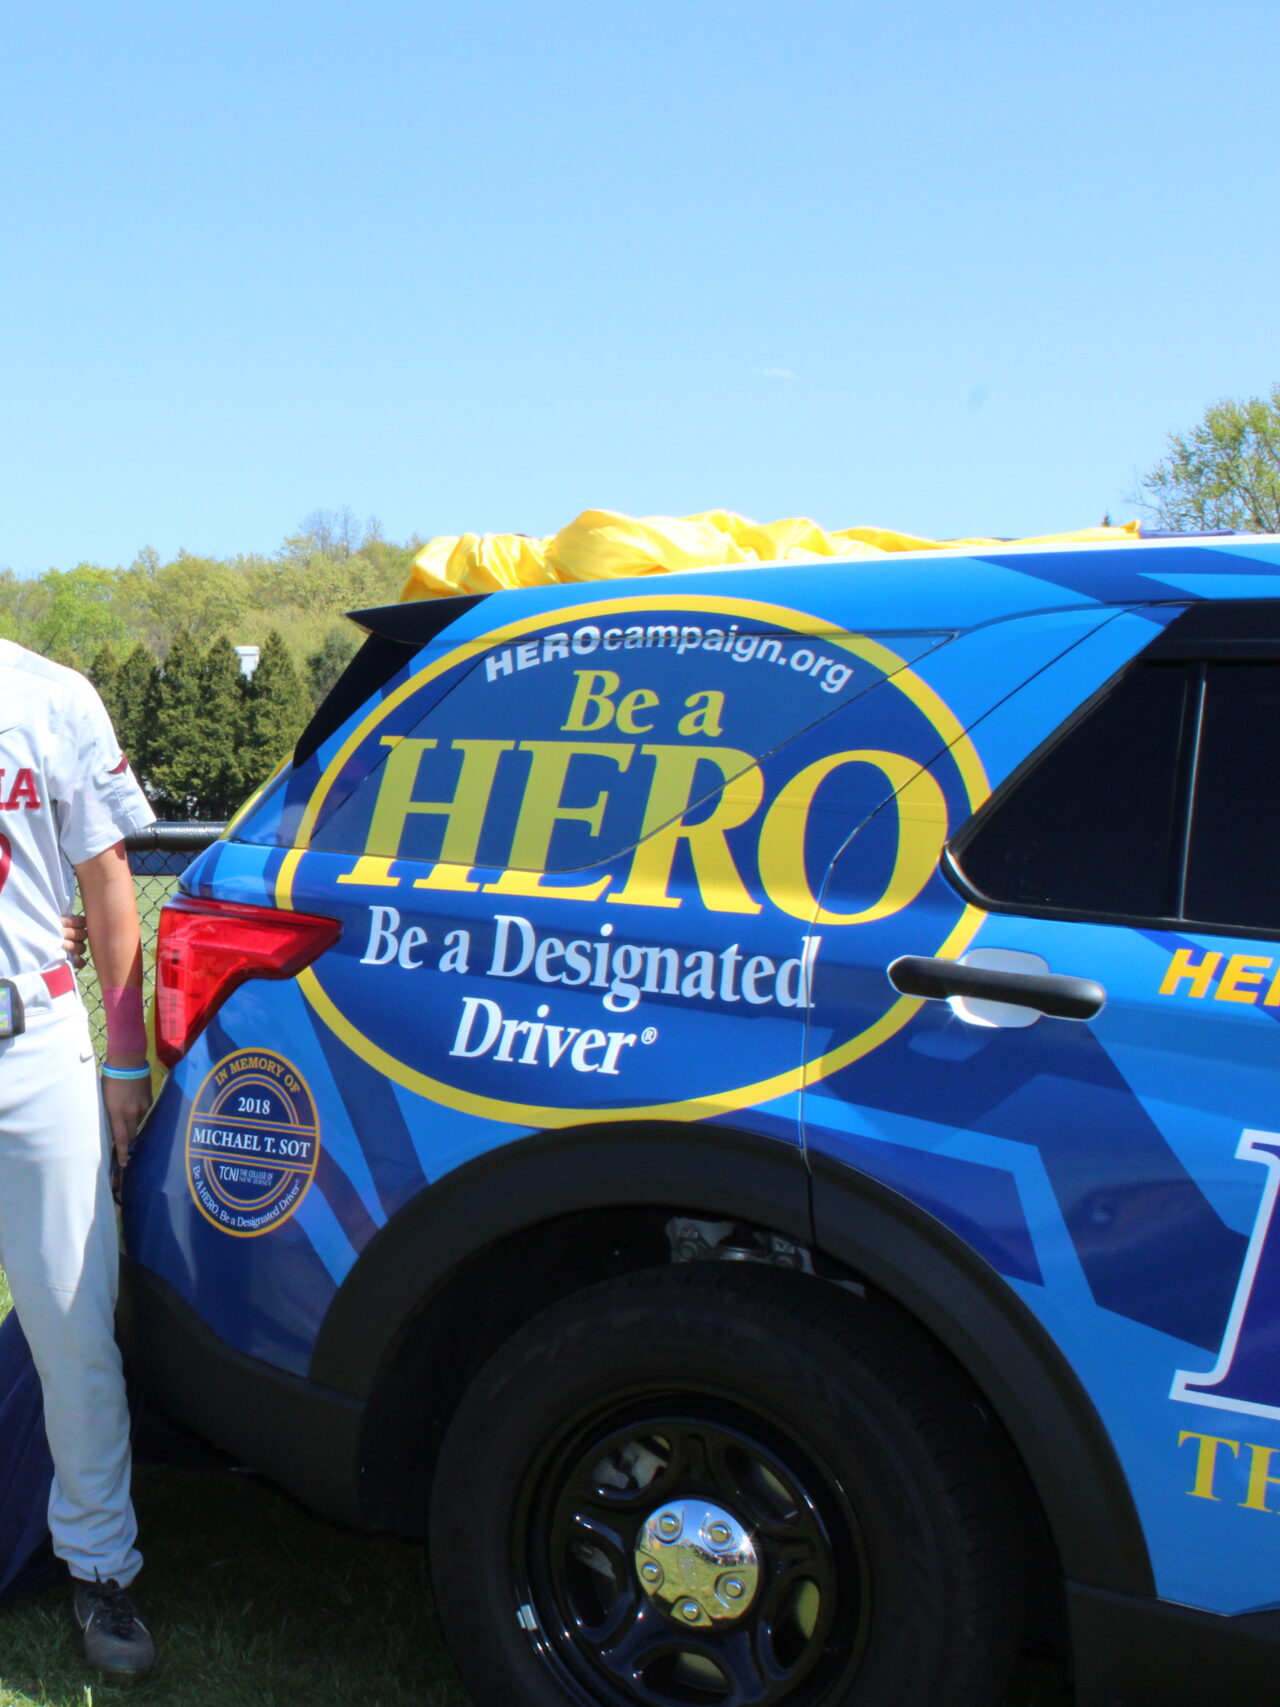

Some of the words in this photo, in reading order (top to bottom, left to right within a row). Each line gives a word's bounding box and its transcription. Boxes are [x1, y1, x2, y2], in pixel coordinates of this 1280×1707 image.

[485, 625, 853, 693] HEROcampaign.org
[561, 670, 659, 734] Be
[678, 690, 725, 737] a
[336, 736, 948, 925] HERO
[360, 906, 428, 970] Be
[439, 930, 470, 975] a
[486, 914, 822, 1011] Designated
[1158, 948, 1280, 1007] HE
[214, 1068, 229, 1086] IN
[229, 1056, 285, 1078] MEMORY
[284, 1074, 301, 1093] OF
[238, 1097, 271, 1115] 2018
[192, 1127, 261, 1152] MICHAEL
[264, 1137, 276, 1154] T.
[278, 1139, 311, 1158] SOT
[219, 1165, 240, 1181] TCNJ
[219, 1210, 230, 1224] Be
[230, 1218, 236, 1226] a
[237, 1206, 281, 1229] Designated
